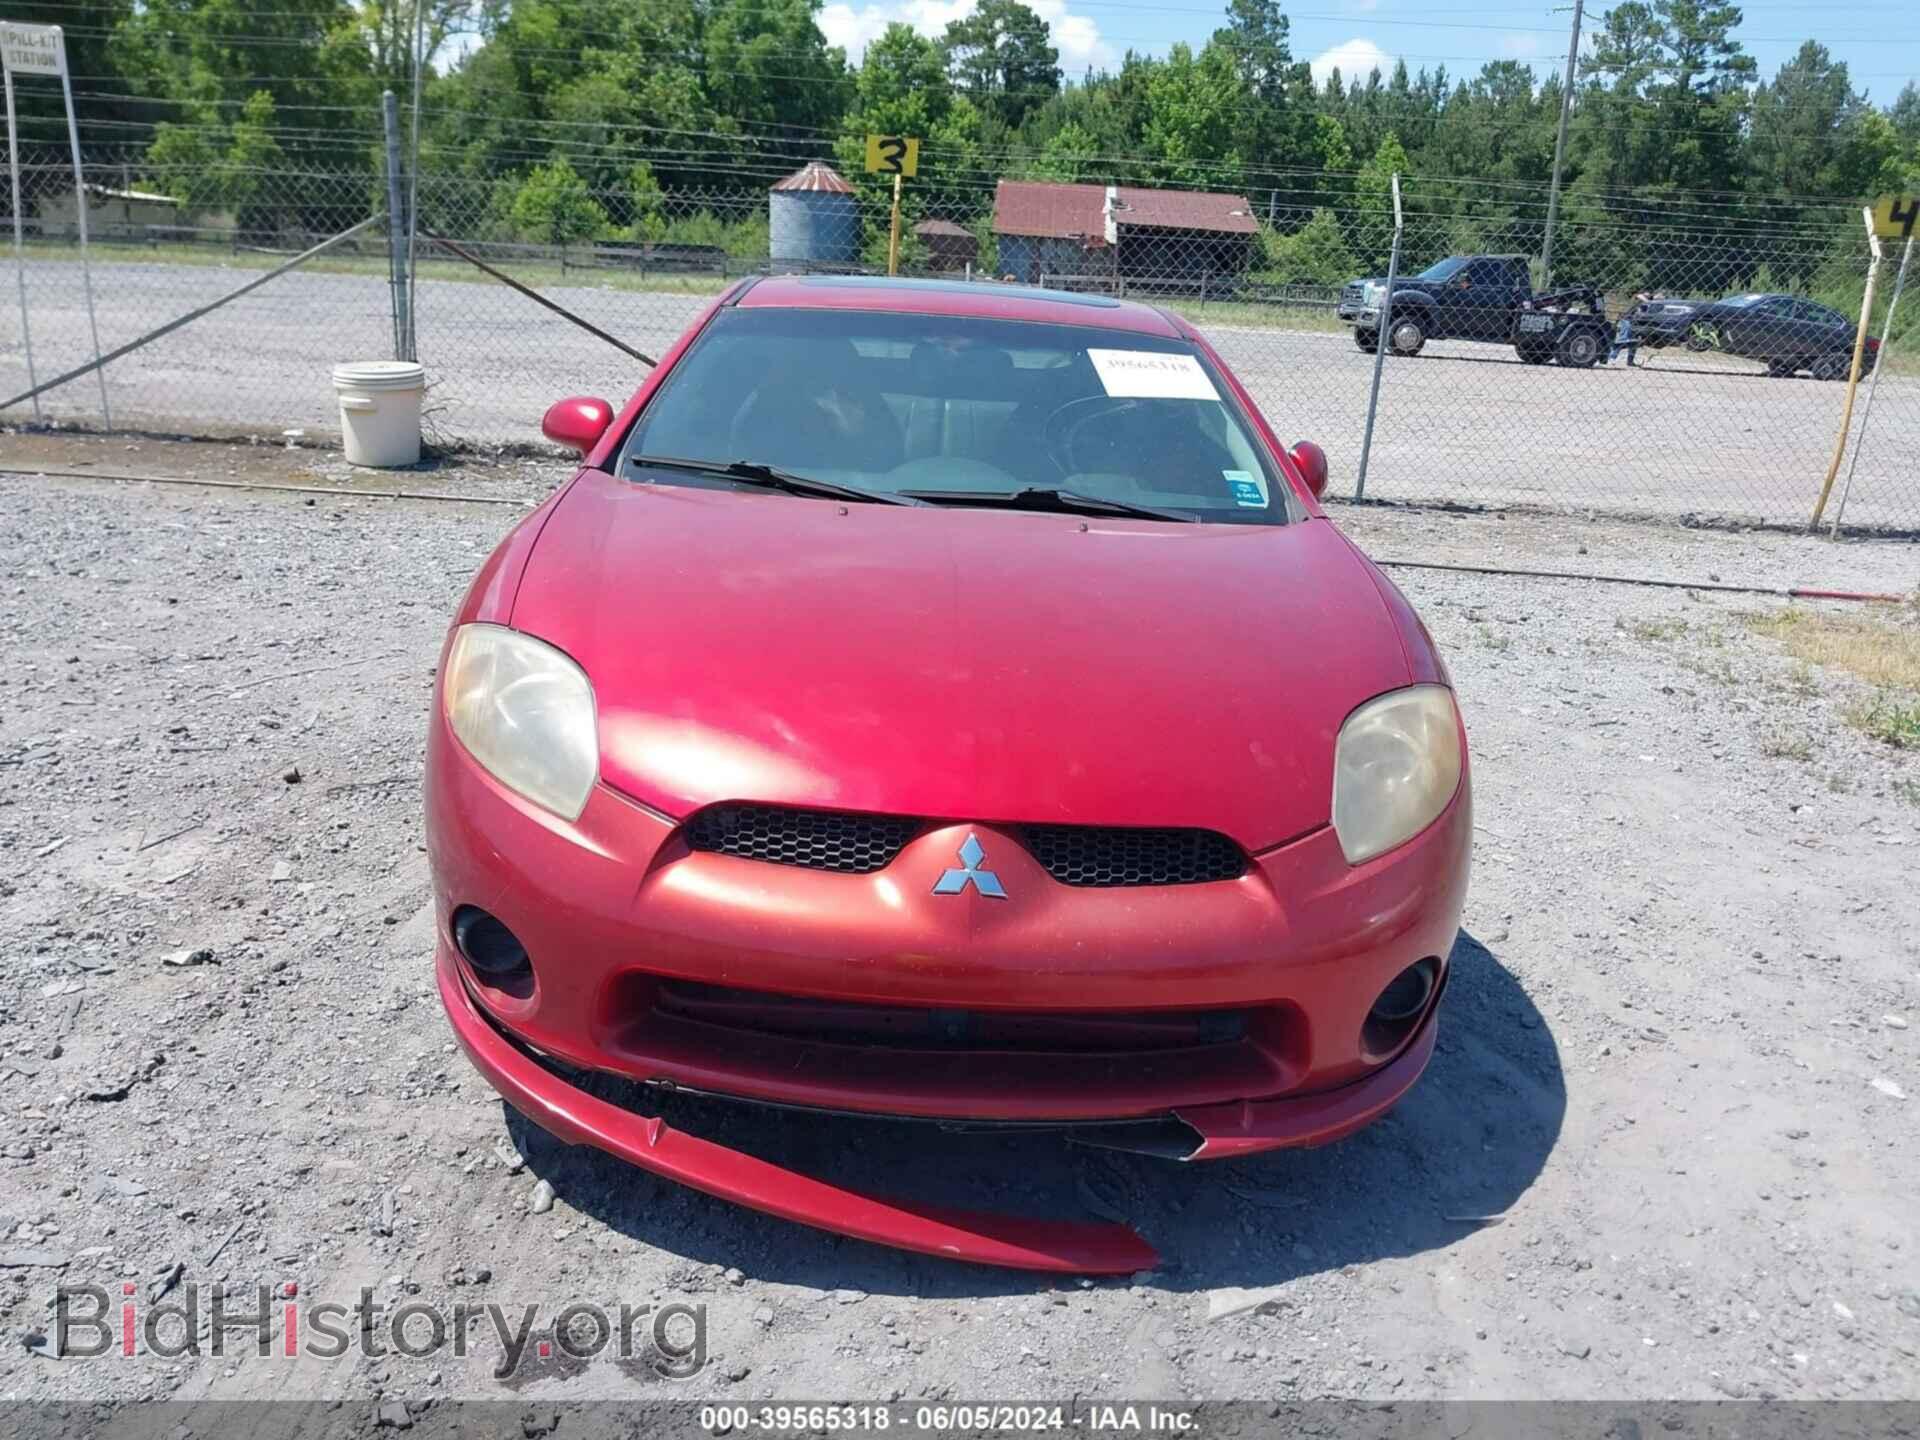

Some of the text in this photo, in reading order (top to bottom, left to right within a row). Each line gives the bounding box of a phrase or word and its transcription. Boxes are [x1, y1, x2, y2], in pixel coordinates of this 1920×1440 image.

[10, 50, 57, 66] STATION
[878, 138, 907, 174] 3
[1889, 198, 1920, 238] 4
